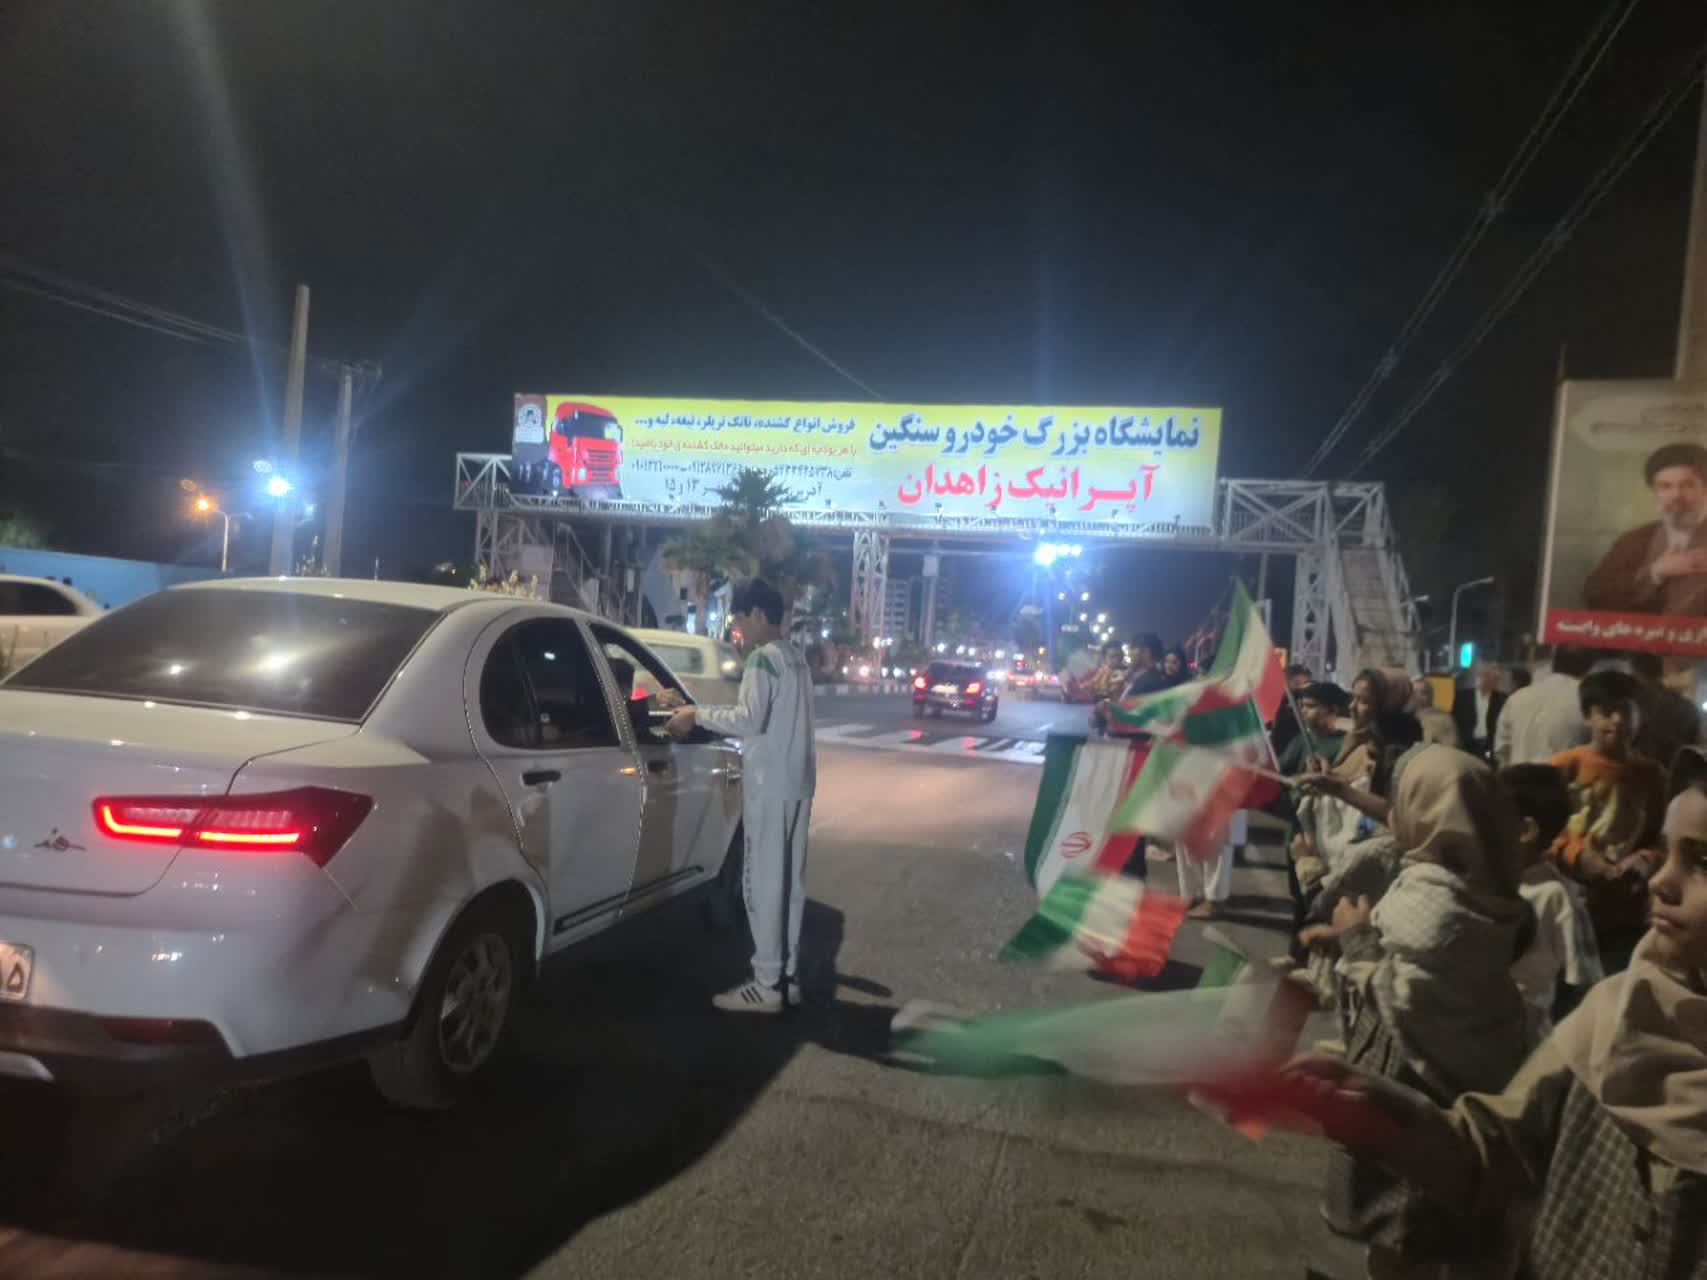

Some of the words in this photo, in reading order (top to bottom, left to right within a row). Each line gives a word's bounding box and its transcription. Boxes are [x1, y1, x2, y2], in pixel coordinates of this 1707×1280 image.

[793, 416, 821, 433] انواع
[821, 416, 856, 434] فروش
[869, 414, 940, 451] سنگین
[941, 414, 1019, 454] خودرو
[1023, 415, 1091, 456] بزرگ
[1094, 415, 1199, 456] نمایشگاه
[897, 462, 1003, 509] زاهدان
[1008, 464, 1160, 512] آپرانیک
